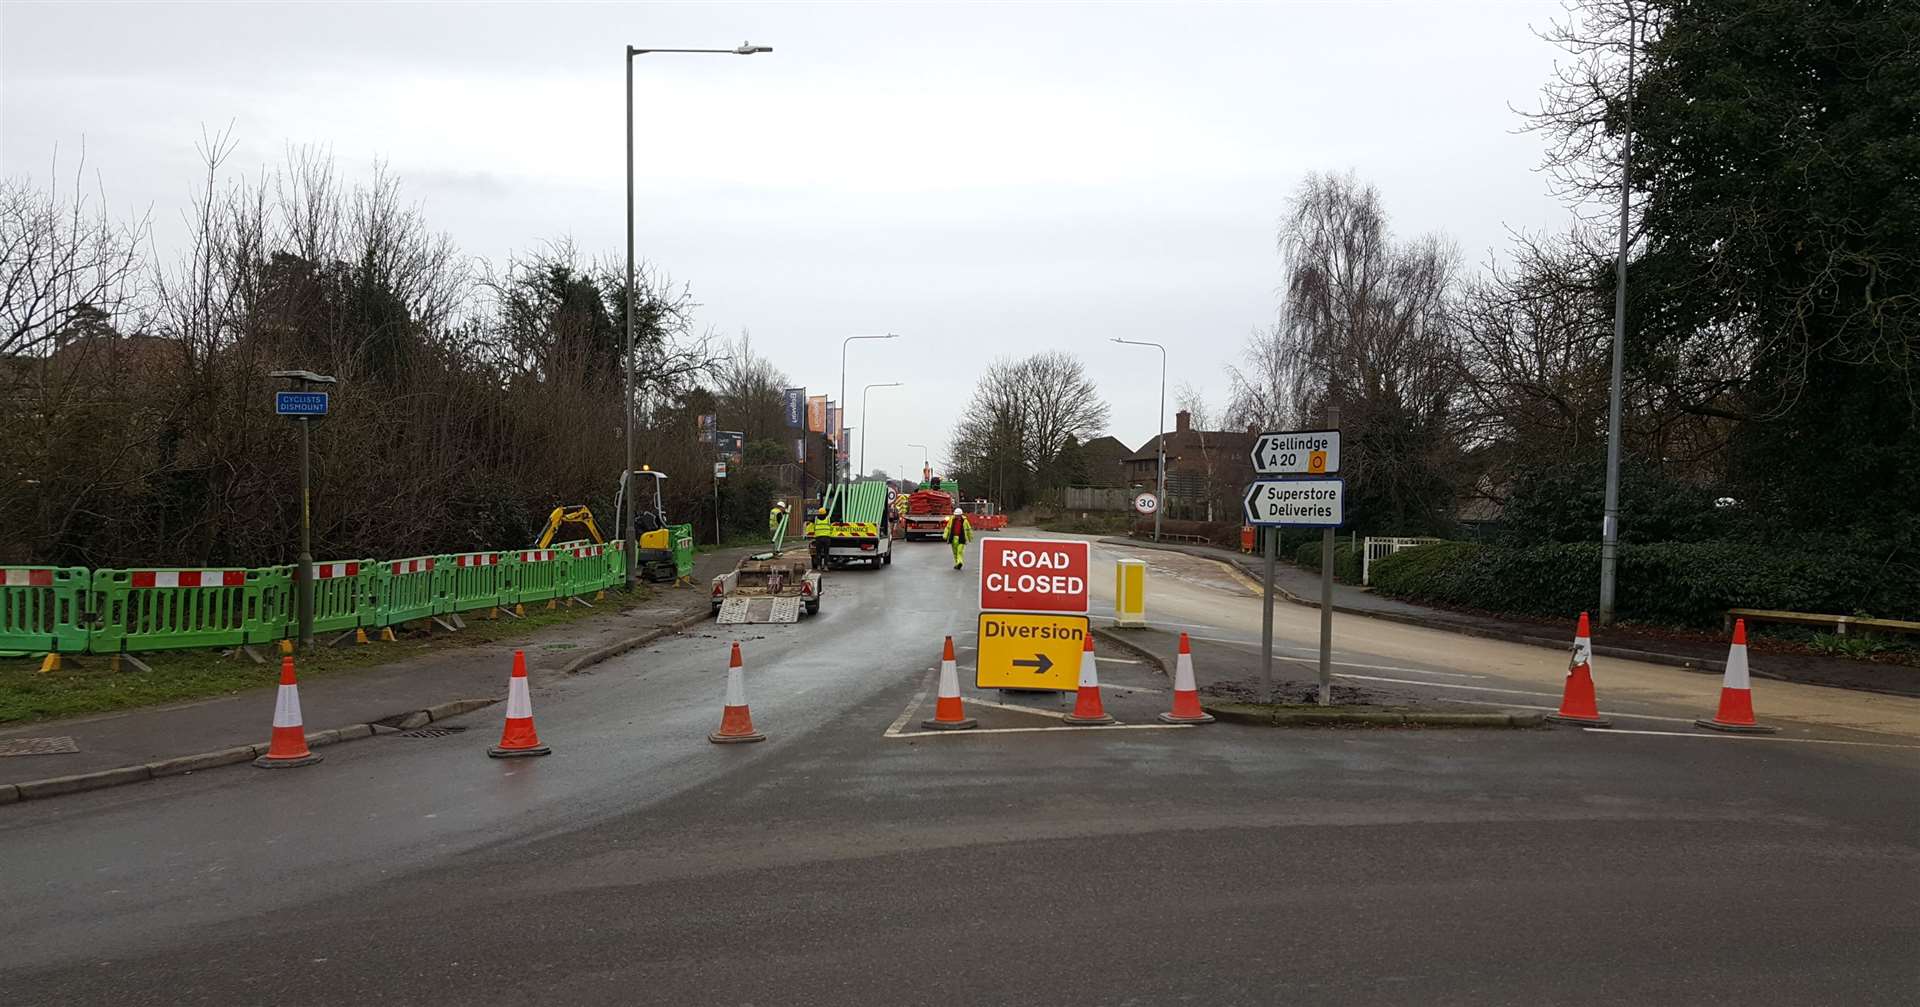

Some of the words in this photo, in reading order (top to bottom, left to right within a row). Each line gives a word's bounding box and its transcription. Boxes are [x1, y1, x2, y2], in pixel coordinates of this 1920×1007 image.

[1271, 437, 1328, 451] Sellindge
[1267, 487, 1336, 502] Superstore
[1139, 498, 1155, 508] 30
[1269, 503, 1332, 516] Deliveries
[1002, 549, 1070, 569] ROAD
[986, 573, 1084, 595] CLOSED
[985, 621, 1083, 641] Diversion
